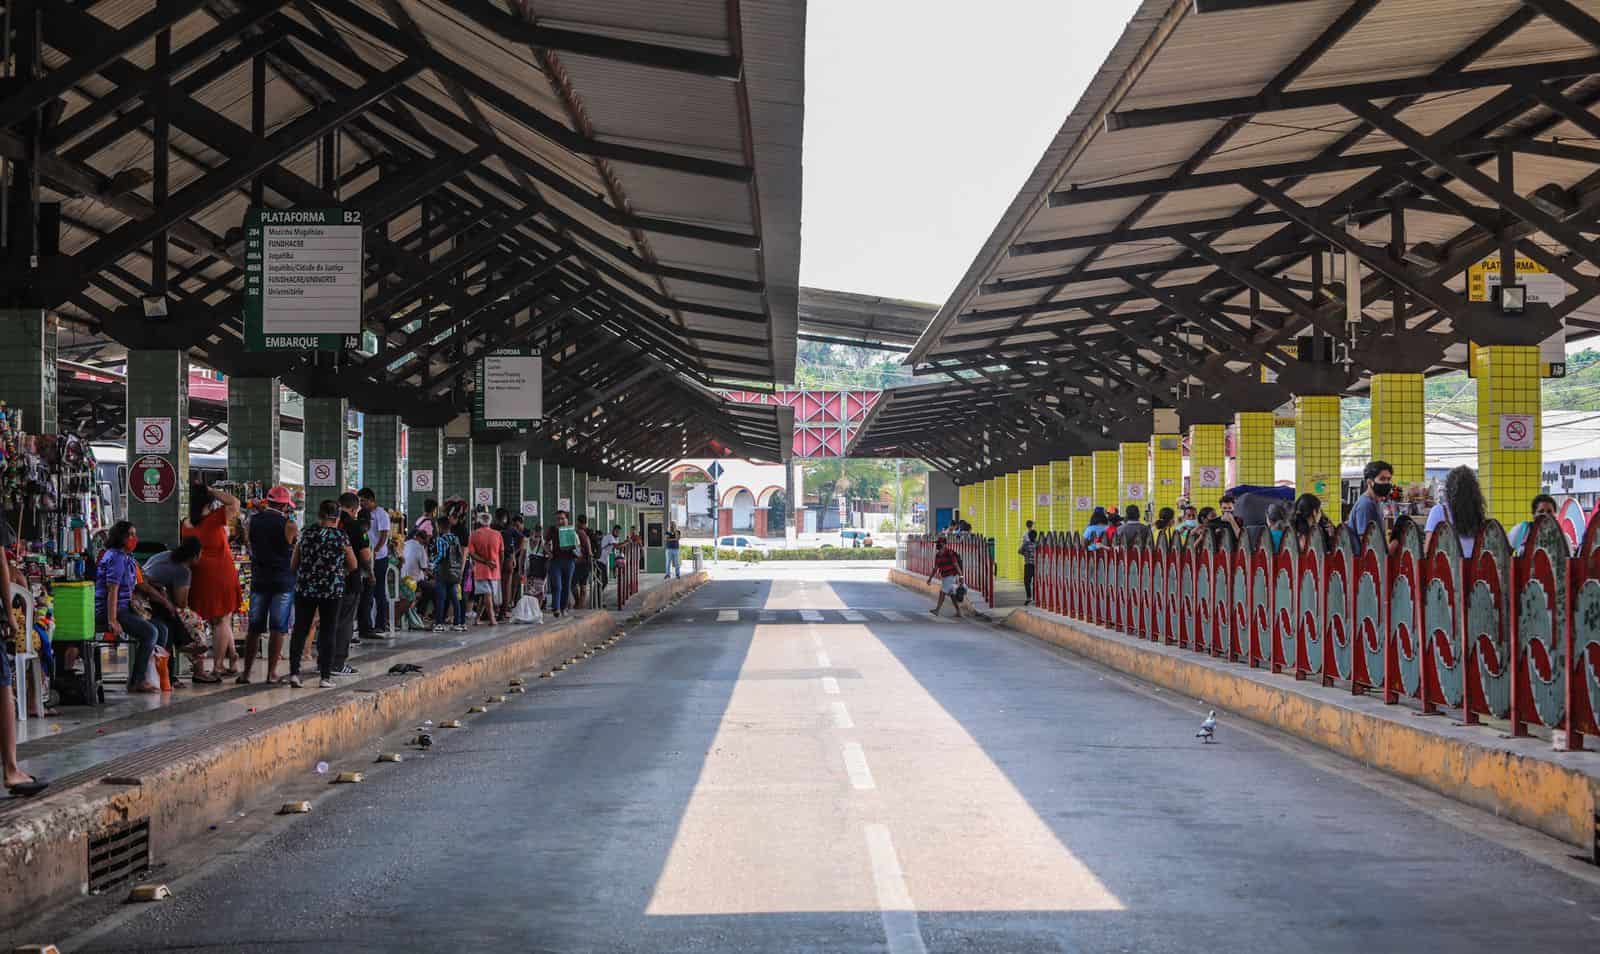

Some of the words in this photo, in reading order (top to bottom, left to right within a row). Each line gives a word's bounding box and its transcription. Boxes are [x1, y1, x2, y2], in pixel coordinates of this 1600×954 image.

[260, 211, 325, 223] PLATAFORMA
[343, 211, 361, 223] B2
[1481, 261, 1534, 270] PLATRMA
[265, 336, 319, 349] EMBARQUE
